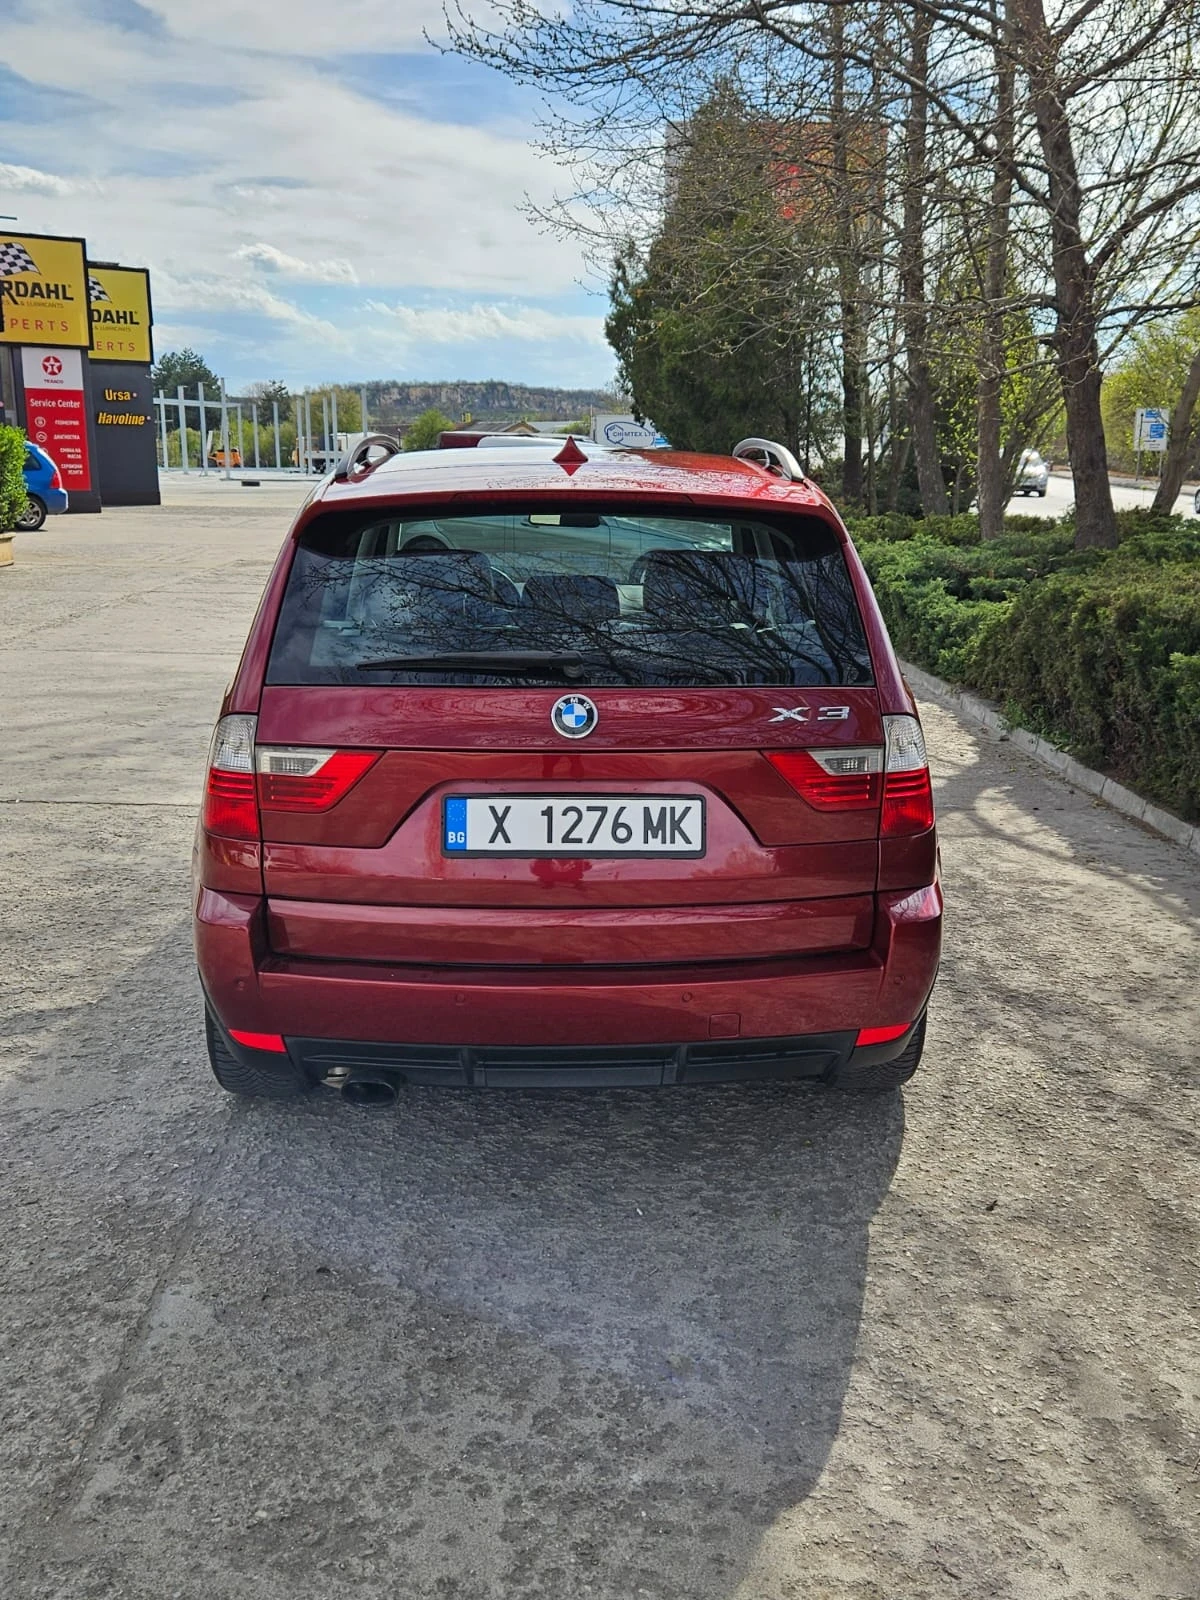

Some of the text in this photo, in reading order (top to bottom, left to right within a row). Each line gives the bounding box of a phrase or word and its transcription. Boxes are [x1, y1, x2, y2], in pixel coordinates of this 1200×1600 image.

[105, 389, 131, 401] Ursa
[30, 398, 80, 408] Service Center
[98, 412, 145, 425] Havoline
[558, 697, 591, 710] BMW
[488, 805, 693, 844] X 1276 MK
[448, 831, 465, 843] BG
